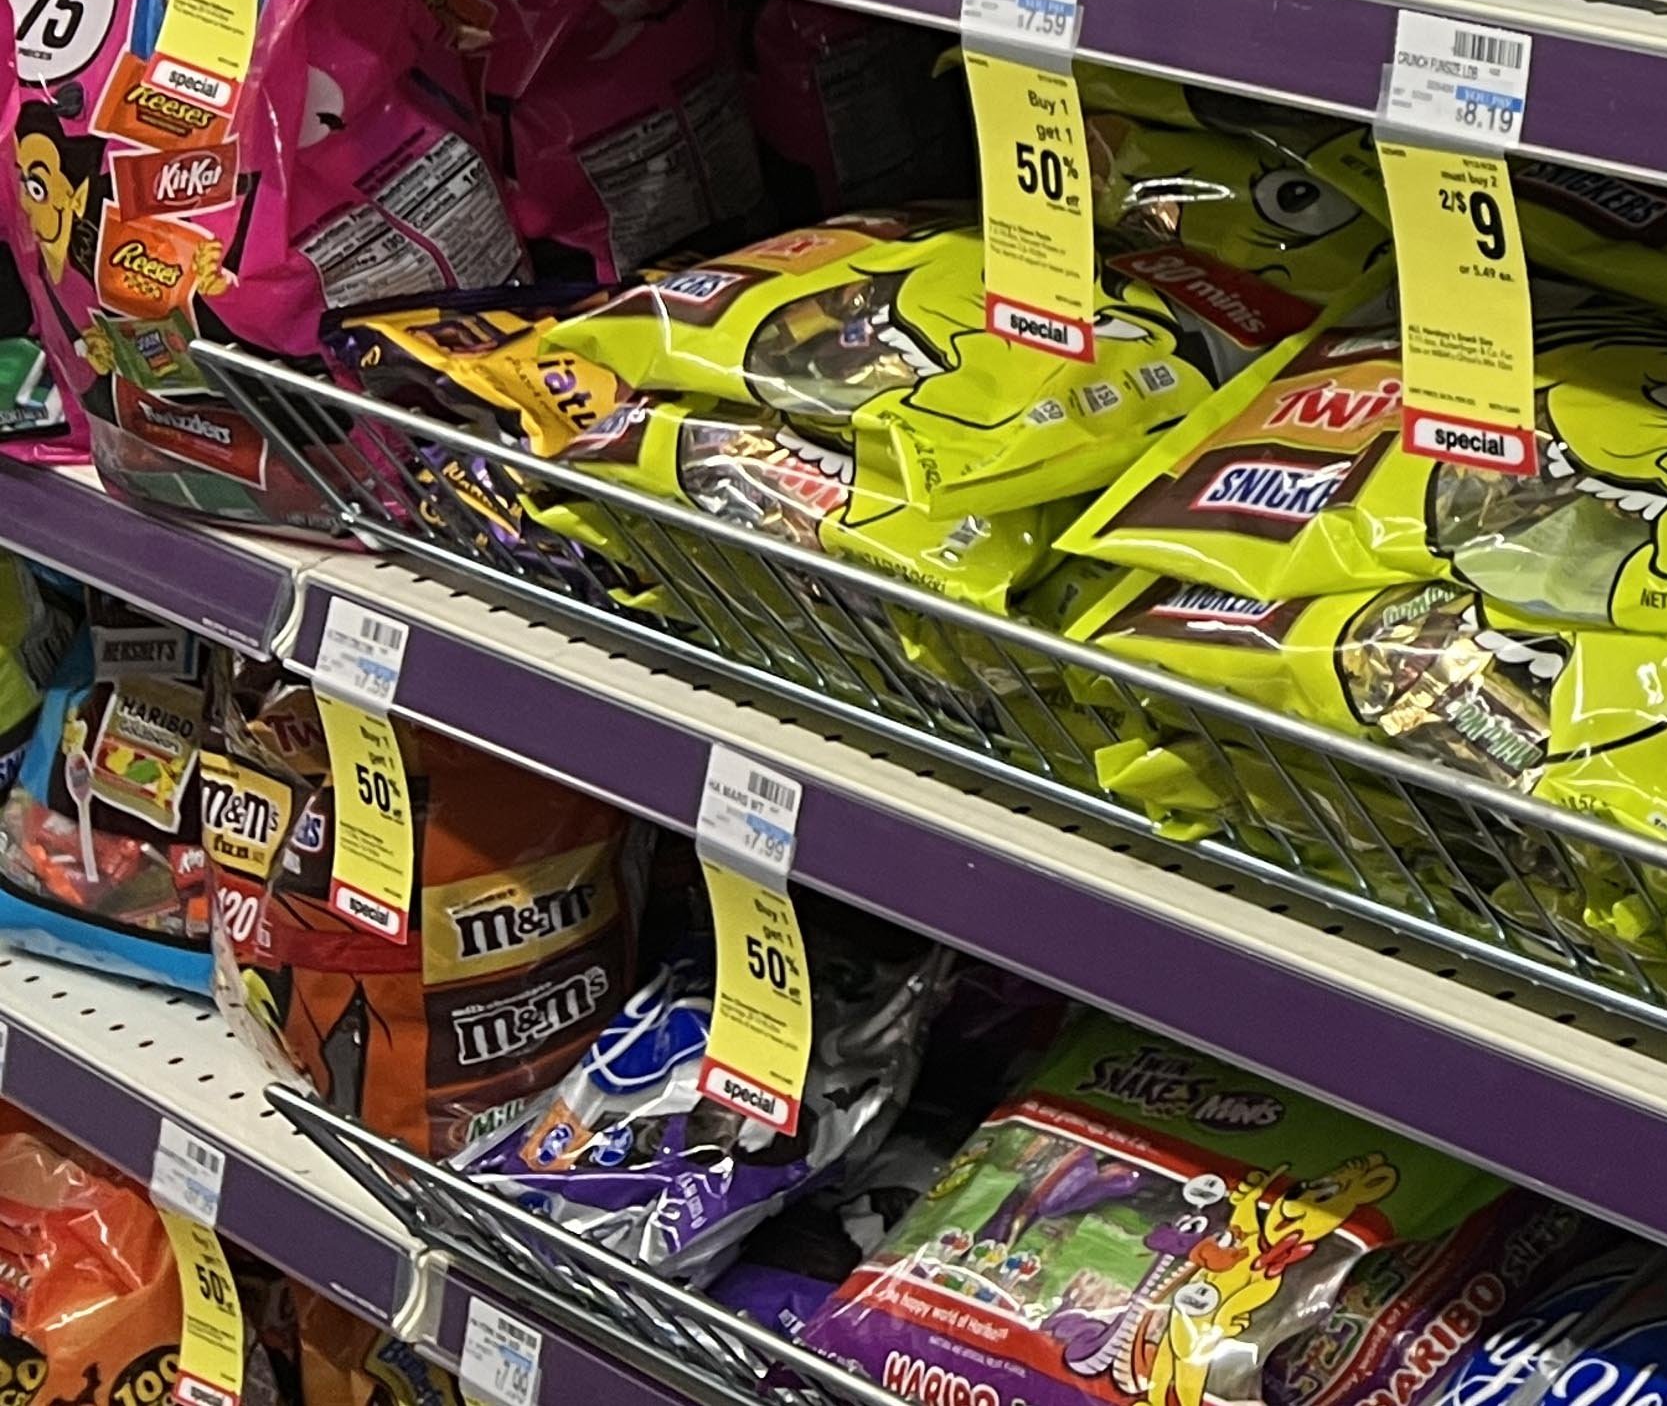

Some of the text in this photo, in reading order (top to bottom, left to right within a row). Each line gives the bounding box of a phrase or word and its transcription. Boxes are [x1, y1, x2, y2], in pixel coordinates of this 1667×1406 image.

[1016, 7, 1068, 37] $7.59
[167, 67, 219, 100] special
[1027, 89, 1058, 117] Buy
[1455, 98, 1515, 135] $8.19
[1035, 123, 1062, 143] get
[156, 161, 224, 202] KitKat
[1014, 139, 1080, 202] 50%
[1440, 170, 1489, 188] must buy
[111, 239, 183, 289] Reese's
[1009, 312, 1069, 346] special
[1270, 372, 1402, 431] Twi
[1434, 428, 1506, 458] special
[1639, 588, 1664, 613] NET
[119, 695, 196, 740] HARIBO
[743, 825, 787, 864] $7.99
[348, 894, 391, 930] special
[722, 1076, 778, 1118] special
